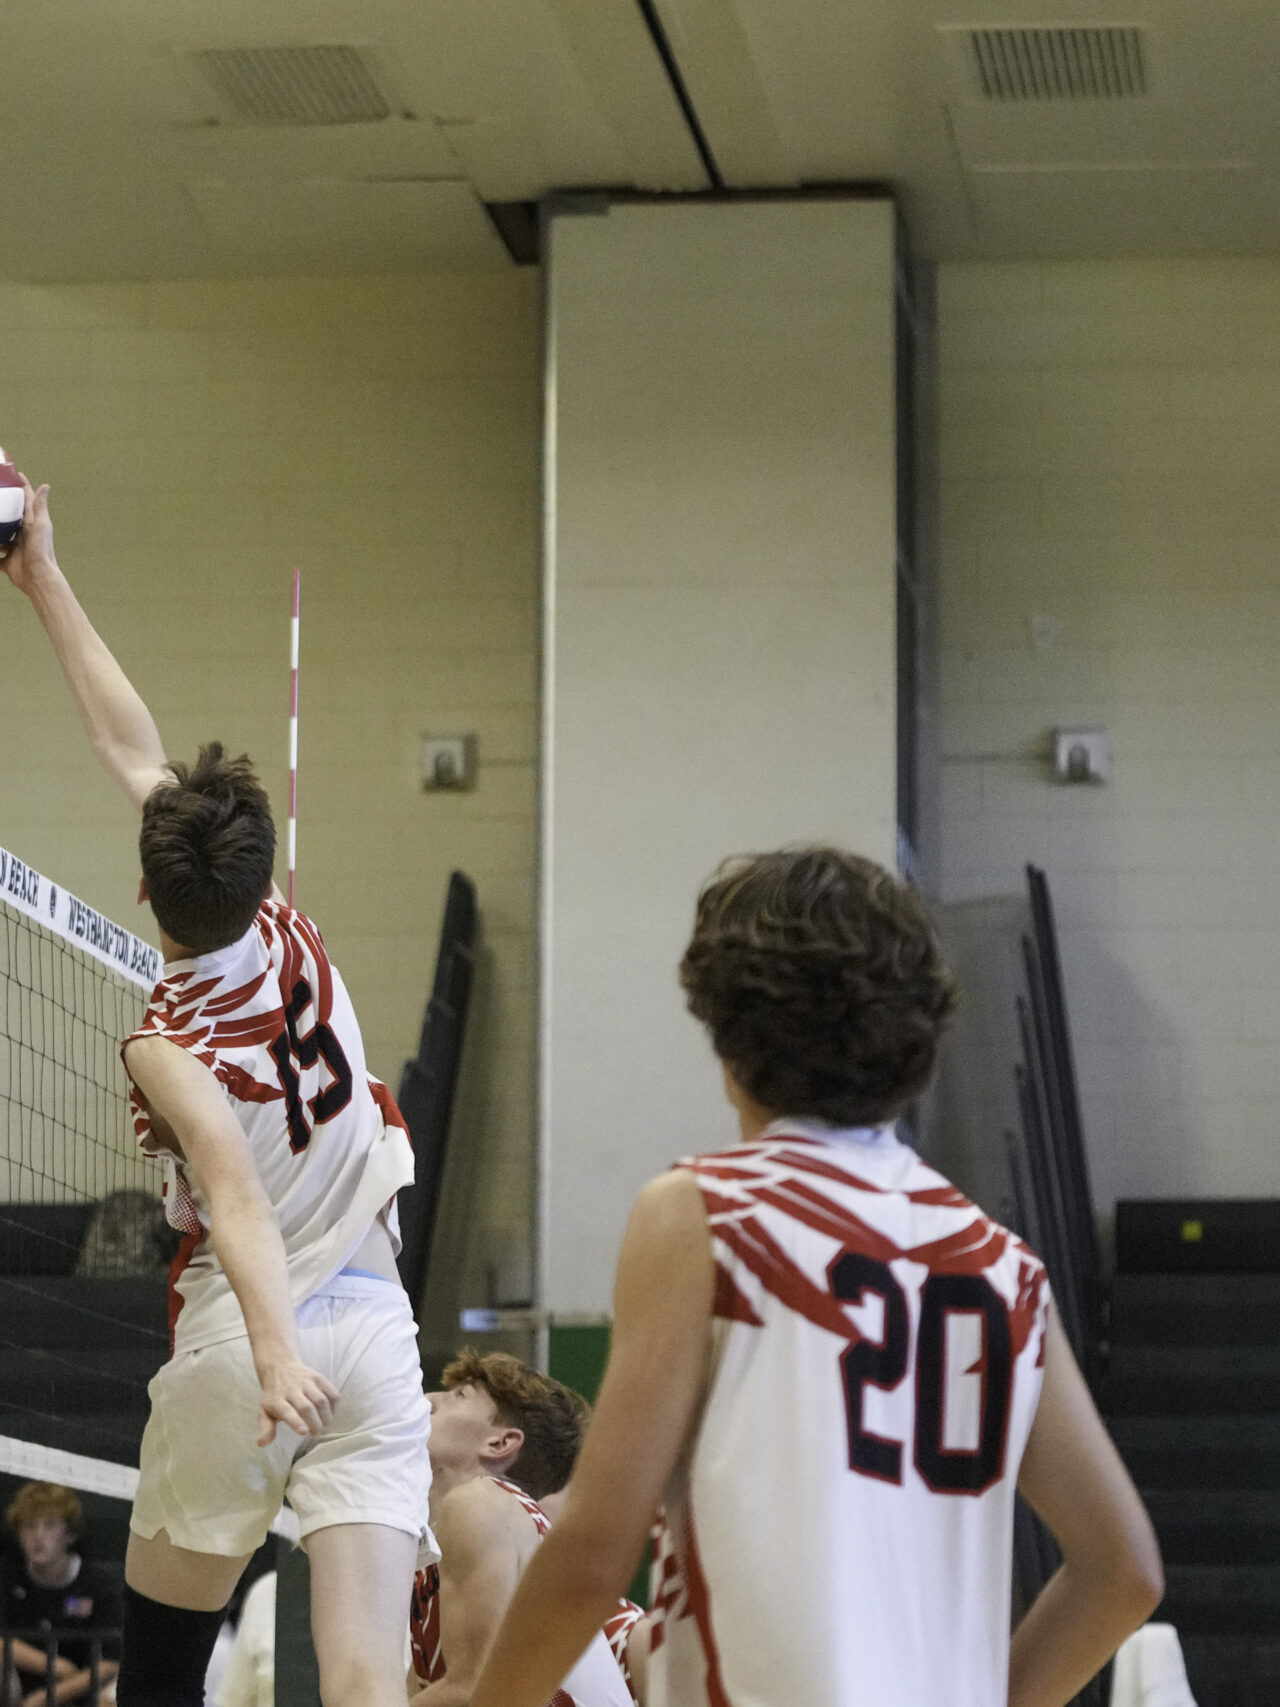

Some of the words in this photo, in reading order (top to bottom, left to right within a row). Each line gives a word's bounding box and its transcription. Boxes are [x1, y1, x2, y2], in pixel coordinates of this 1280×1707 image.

[8, 857, 40, 908] BEACH
[68, 895, 131, 966] WESTHAMPTON
[131, 936, 159, 982] BEACH
[265, 972, 353, 1156] 15
[825, 1250, 1018, 1498] 20
